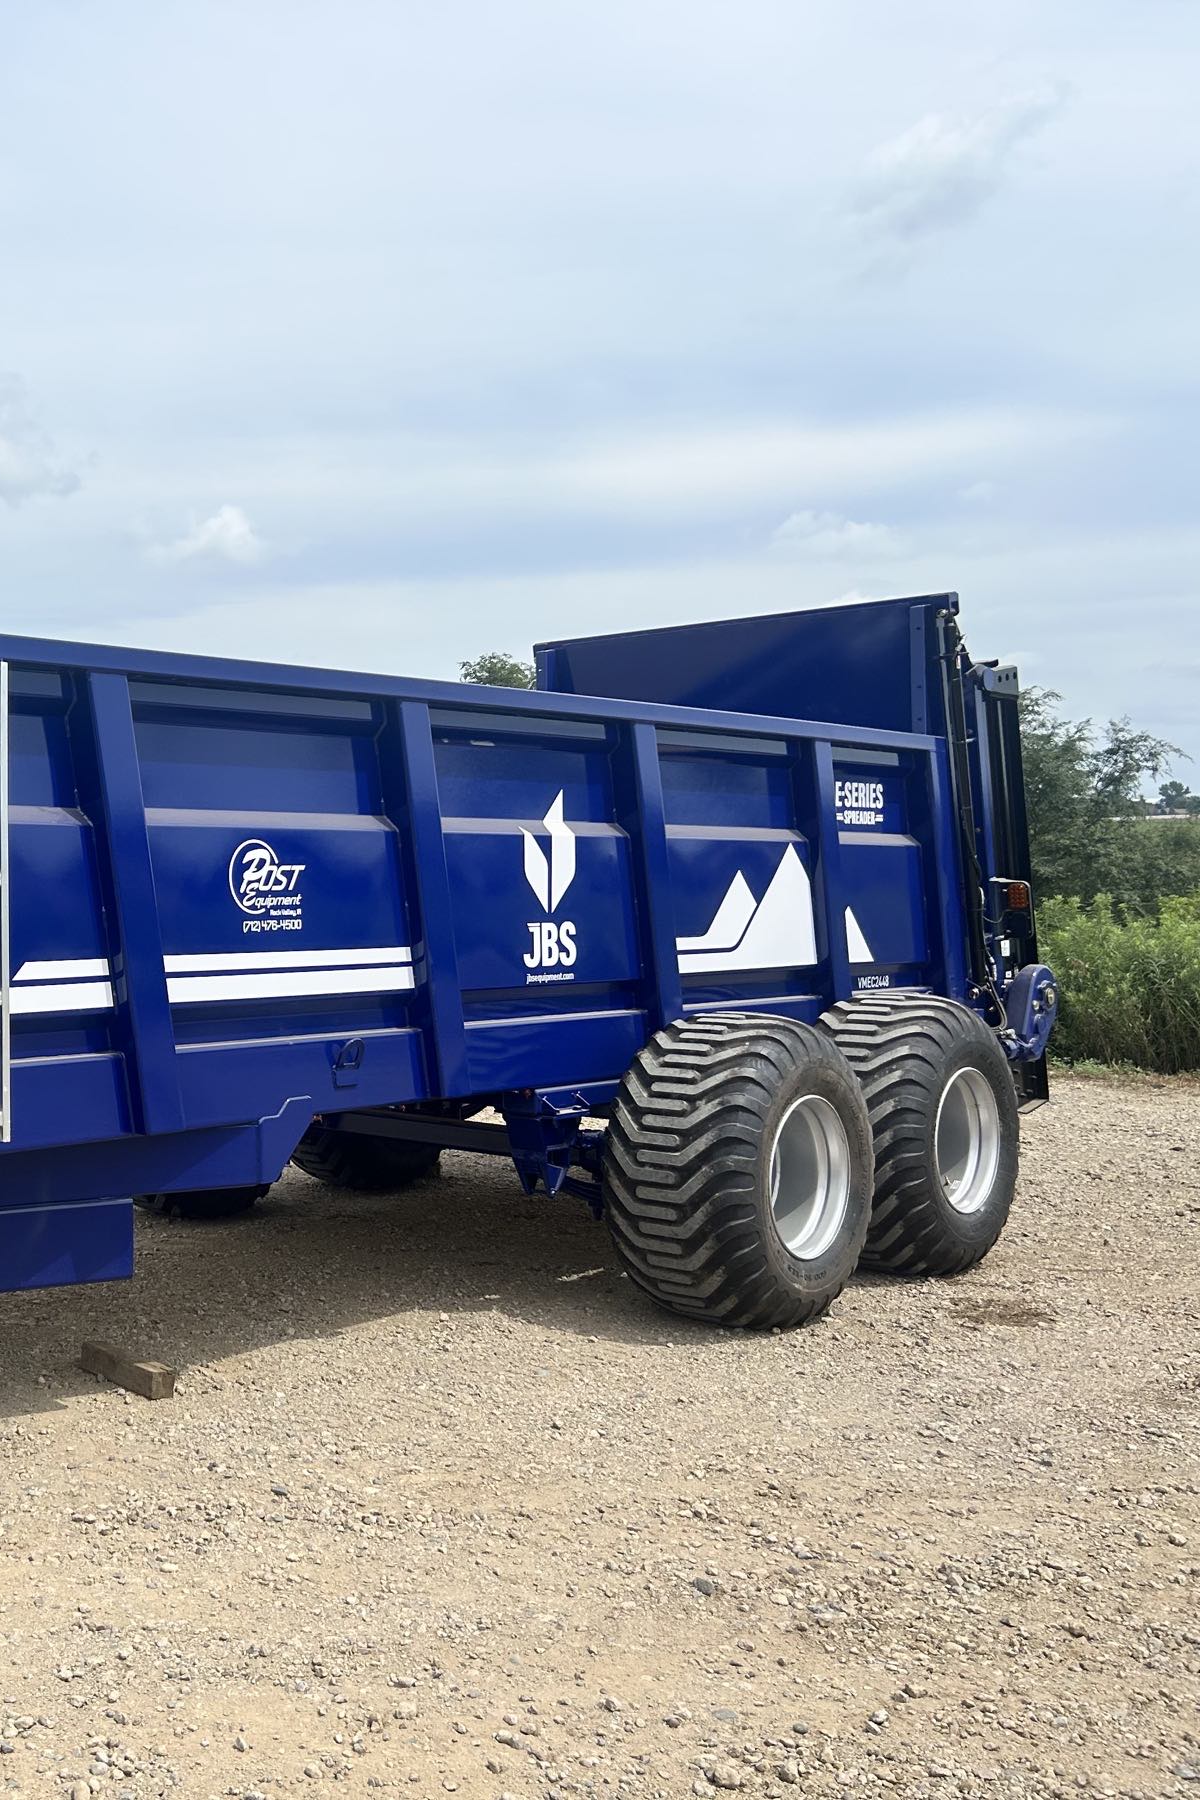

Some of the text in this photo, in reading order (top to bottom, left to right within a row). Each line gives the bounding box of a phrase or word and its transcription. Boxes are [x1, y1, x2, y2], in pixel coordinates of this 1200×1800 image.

[835, 781, 884, 809] E-SERIES
[243, 882, 302, 908] Equipment
[243, 919, 302, 933] (712) 476-4500
[523, 920, 577, 968] JBS
[526, 972, 575, 985] jbsequipment.com
